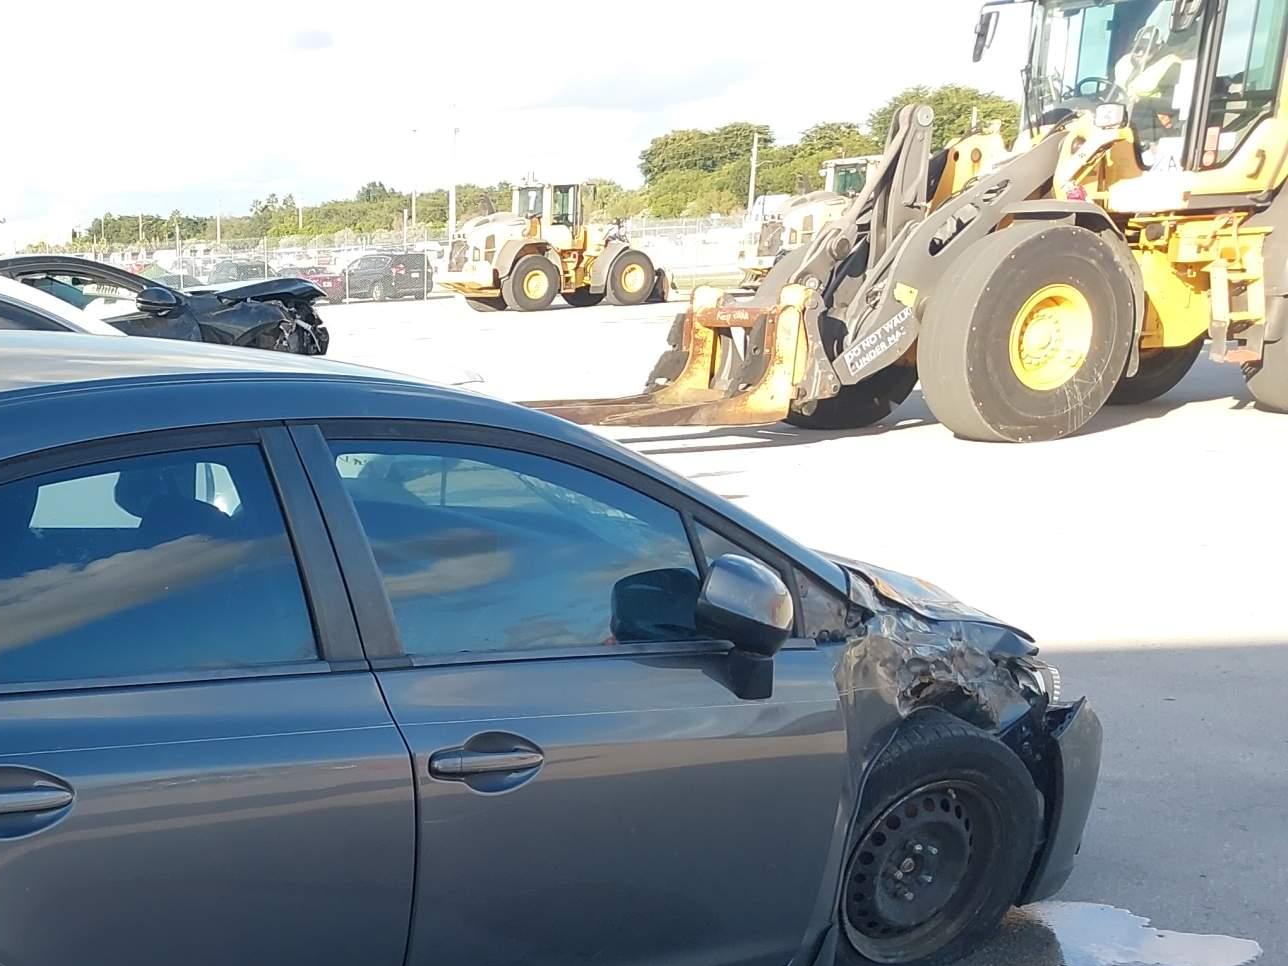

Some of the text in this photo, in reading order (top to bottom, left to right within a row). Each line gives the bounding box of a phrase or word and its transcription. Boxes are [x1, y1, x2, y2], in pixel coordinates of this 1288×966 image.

[845, 347, 861, 362] DO
[862, 332, 882, 351] NOT
[855, 342, 888, 369] UNDER
